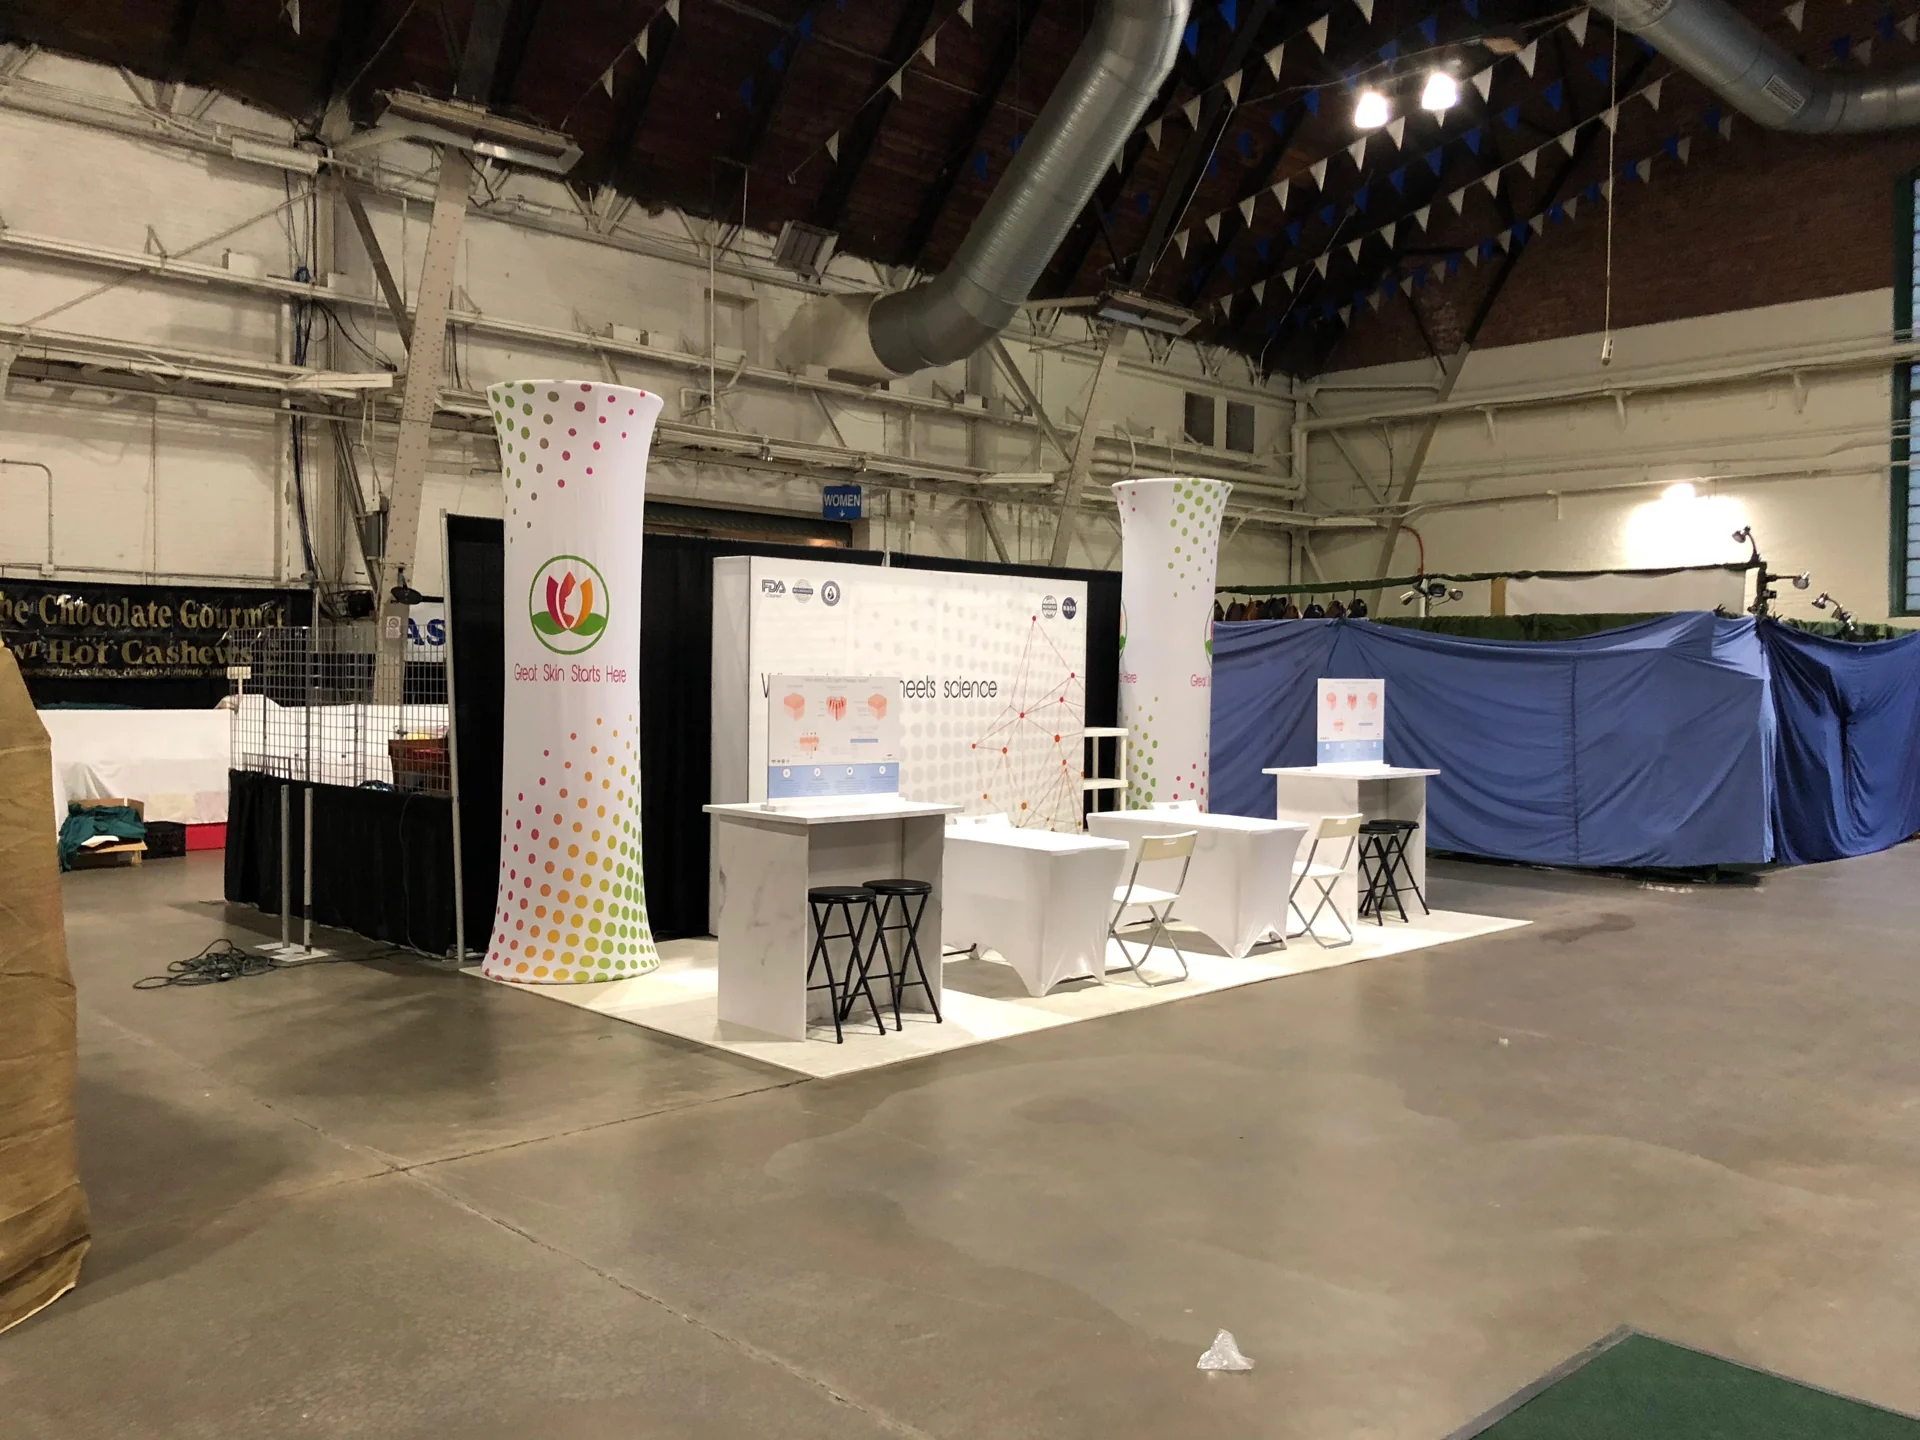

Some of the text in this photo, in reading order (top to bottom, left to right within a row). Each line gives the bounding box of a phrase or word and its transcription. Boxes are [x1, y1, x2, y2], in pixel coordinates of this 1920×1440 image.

[824, 494, 861, 507] WOMEN
[761, 579, 786, 594] FDA
[0, 591, 284, 629] he Chocolate Gourmet
[48, 639, 107, 665] Hot
[121, 639, 253, 667] Cashews
[514, 663, 627, 683] Great Skin Starts Here
[943, 675, 998, 699] science
